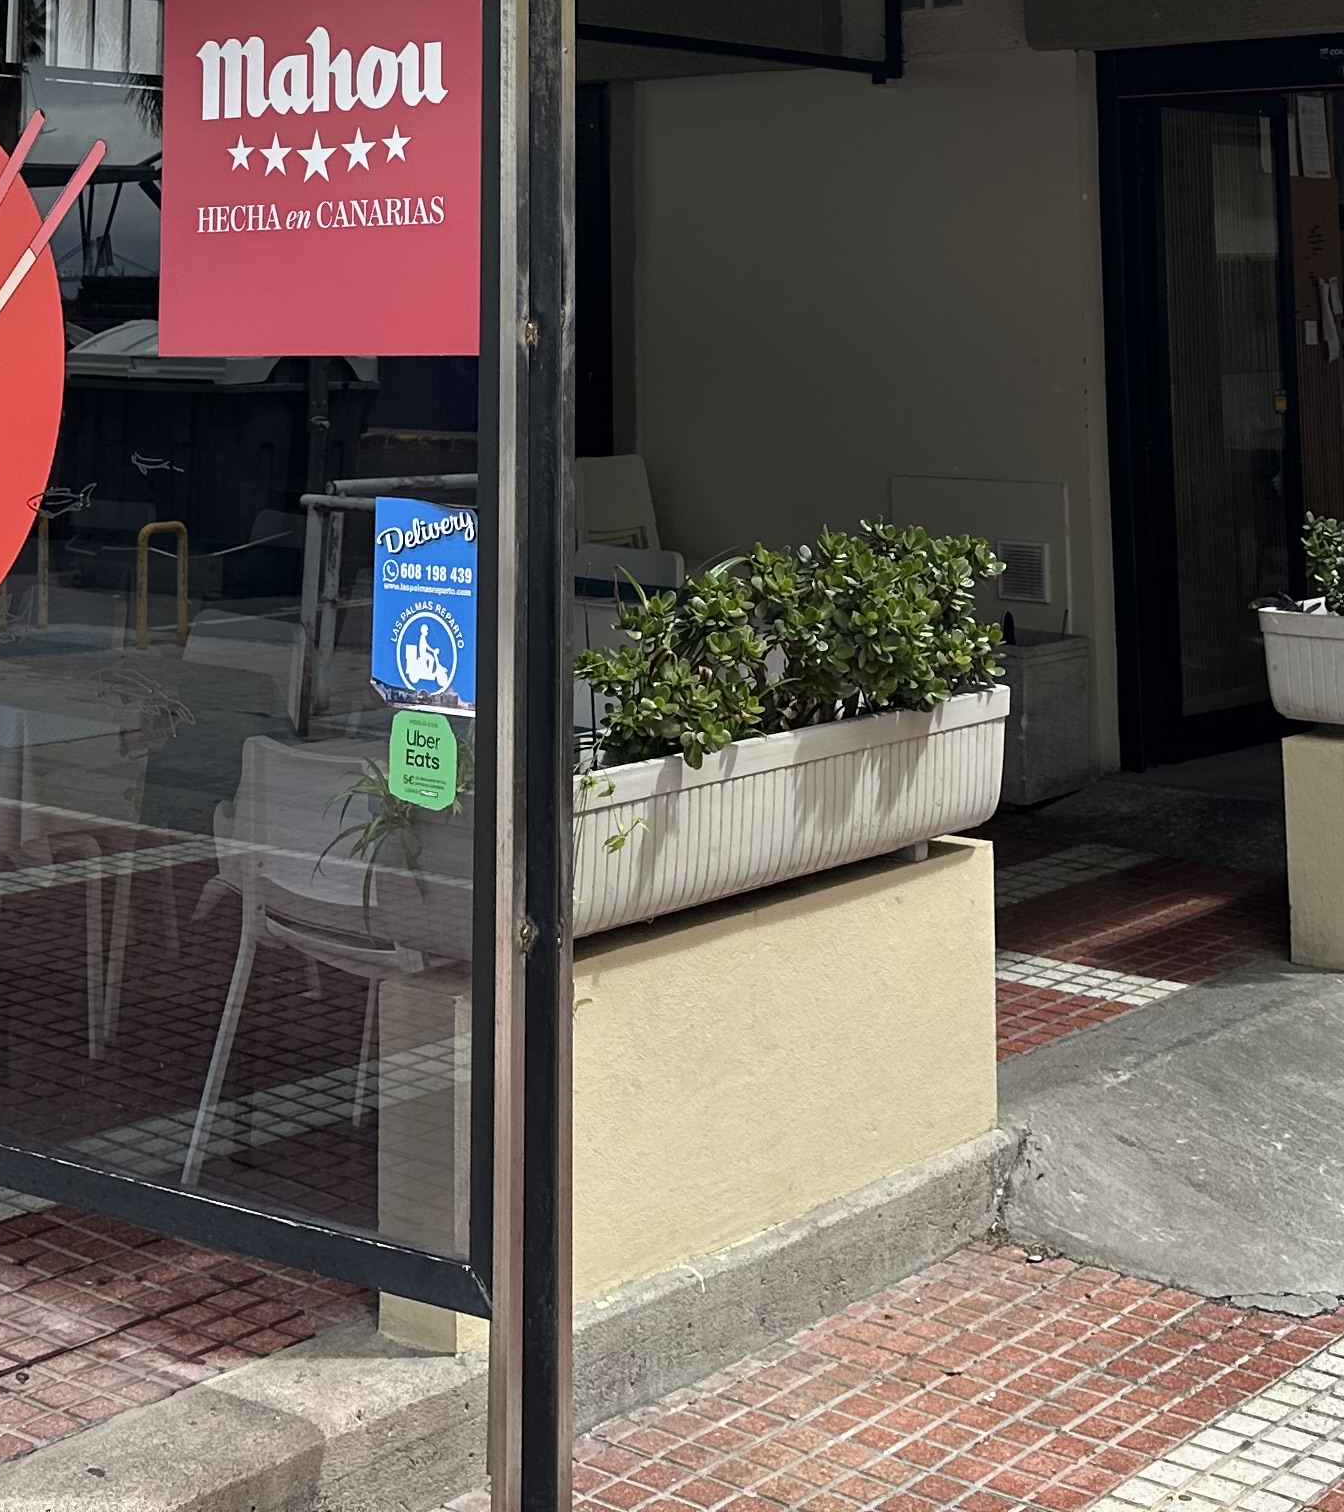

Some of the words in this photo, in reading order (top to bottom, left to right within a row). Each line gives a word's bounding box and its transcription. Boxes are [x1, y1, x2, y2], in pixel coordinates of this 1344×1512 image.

[196, 26, 449, 121] Mahou
[197, 204, 282, 233] HECHA
[286, 208, 311, 230] en
[316, 196, 445, 229] CANARIAS
[376, 512, 475, 554] Delivery
[400, 562, 422, 580] 608
[426, 564, 447, 582] 198
[450, 567, 472, 584] 439
[390, 620, 403, 643] LAS
[400, 600, 434, 621] PALMAS
[435, 603, 465, 649] REPARTO
[406, 728, 441, 750] Uber
[405, 748, 440, 770] Eats
